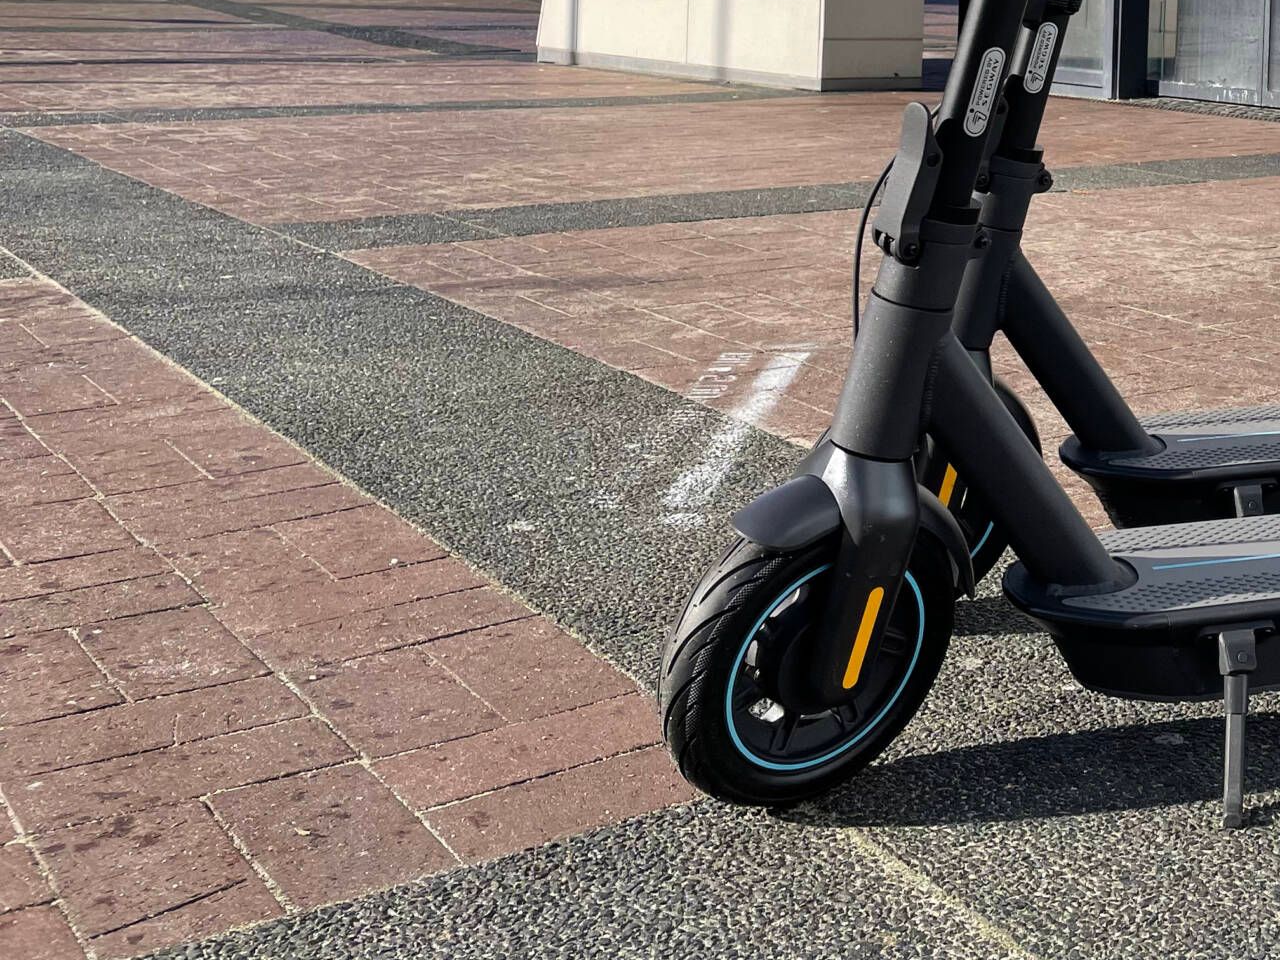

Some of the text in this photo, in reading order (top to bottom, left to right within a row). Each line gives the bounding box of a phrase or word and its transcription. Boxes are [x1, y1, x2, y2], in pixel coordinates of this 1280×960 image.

[1038, 31, 1053, 70] SEGWAY
[975, 57, 993, 106] POWERED BY
[981, 58, 999, 107] SEGWAY
